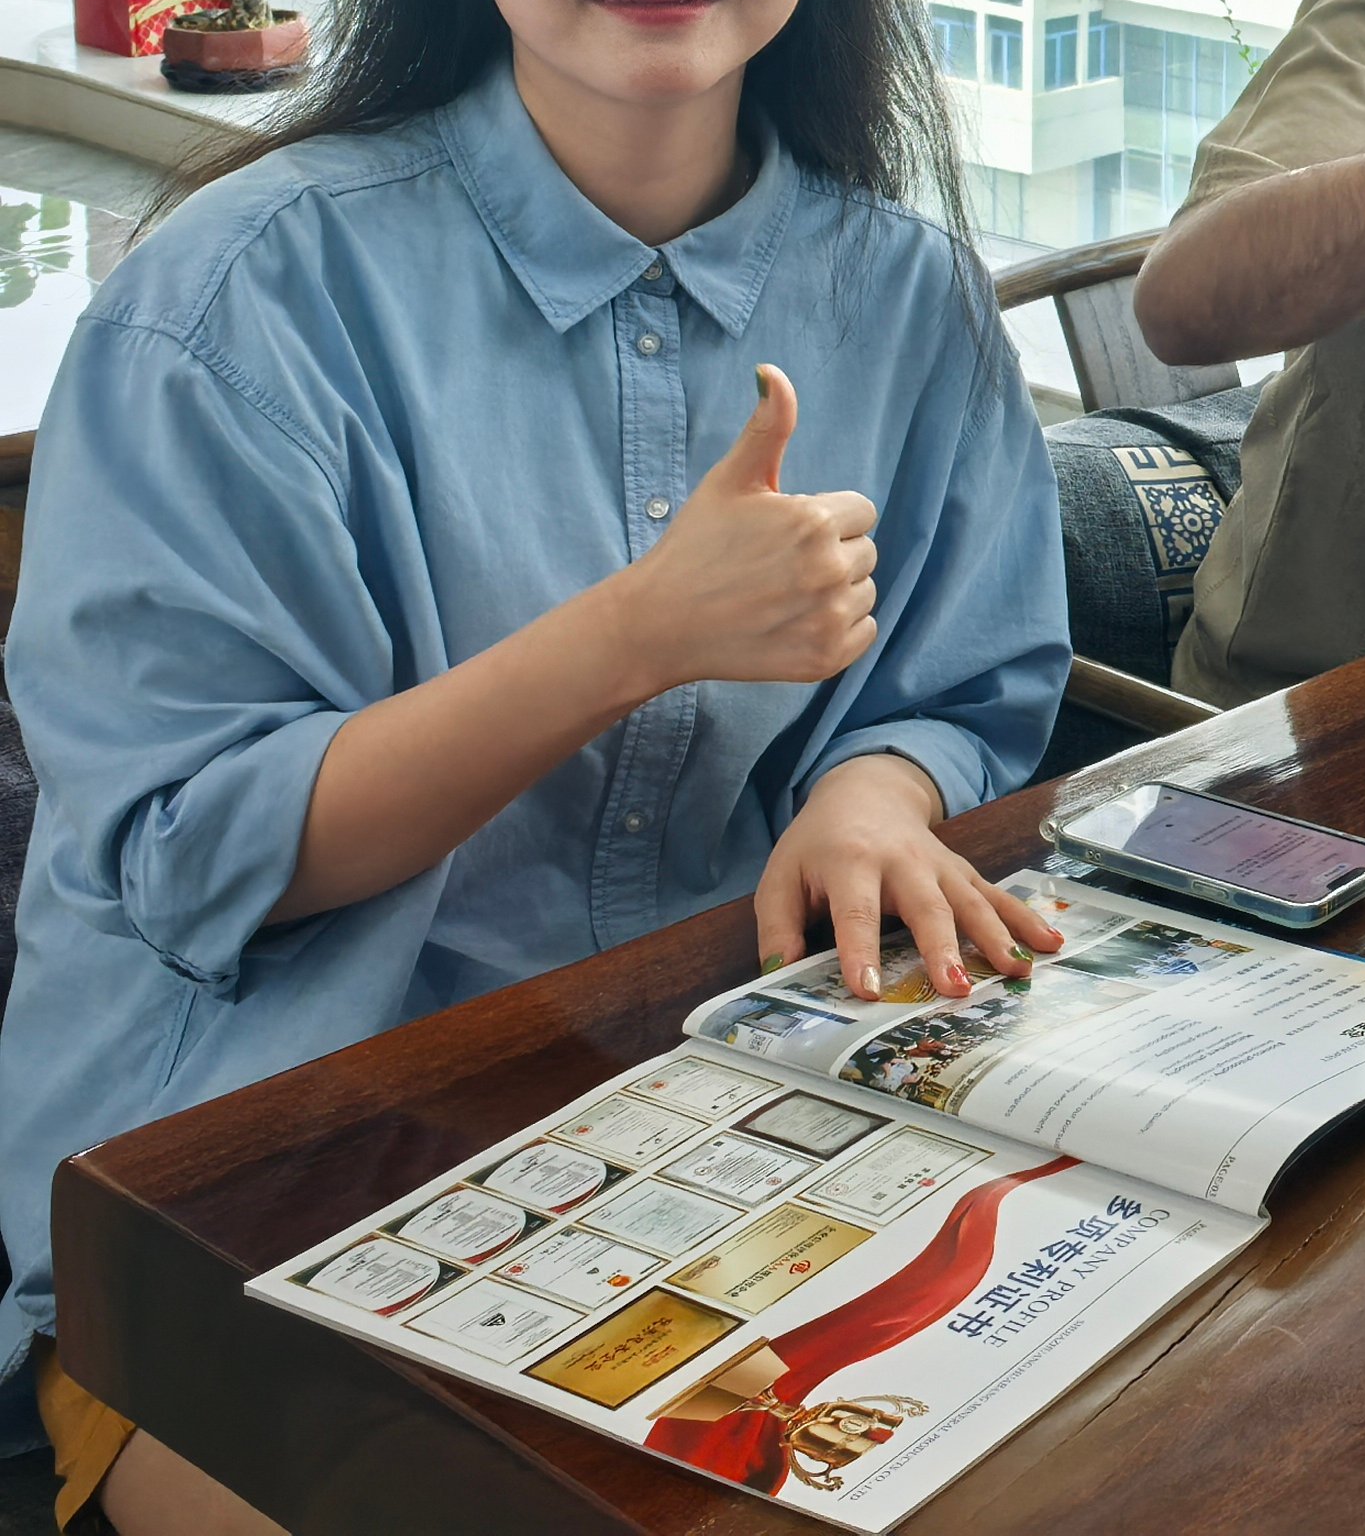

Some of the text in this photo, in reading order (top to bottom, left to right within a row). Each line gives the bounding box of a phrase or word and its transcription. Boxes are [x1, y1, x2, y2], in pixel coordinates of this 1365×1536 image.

[947, 1194, 1142, 1339] 多项专利证书
[983, 1208, 1171, 1349] COMPANY PROFILE
